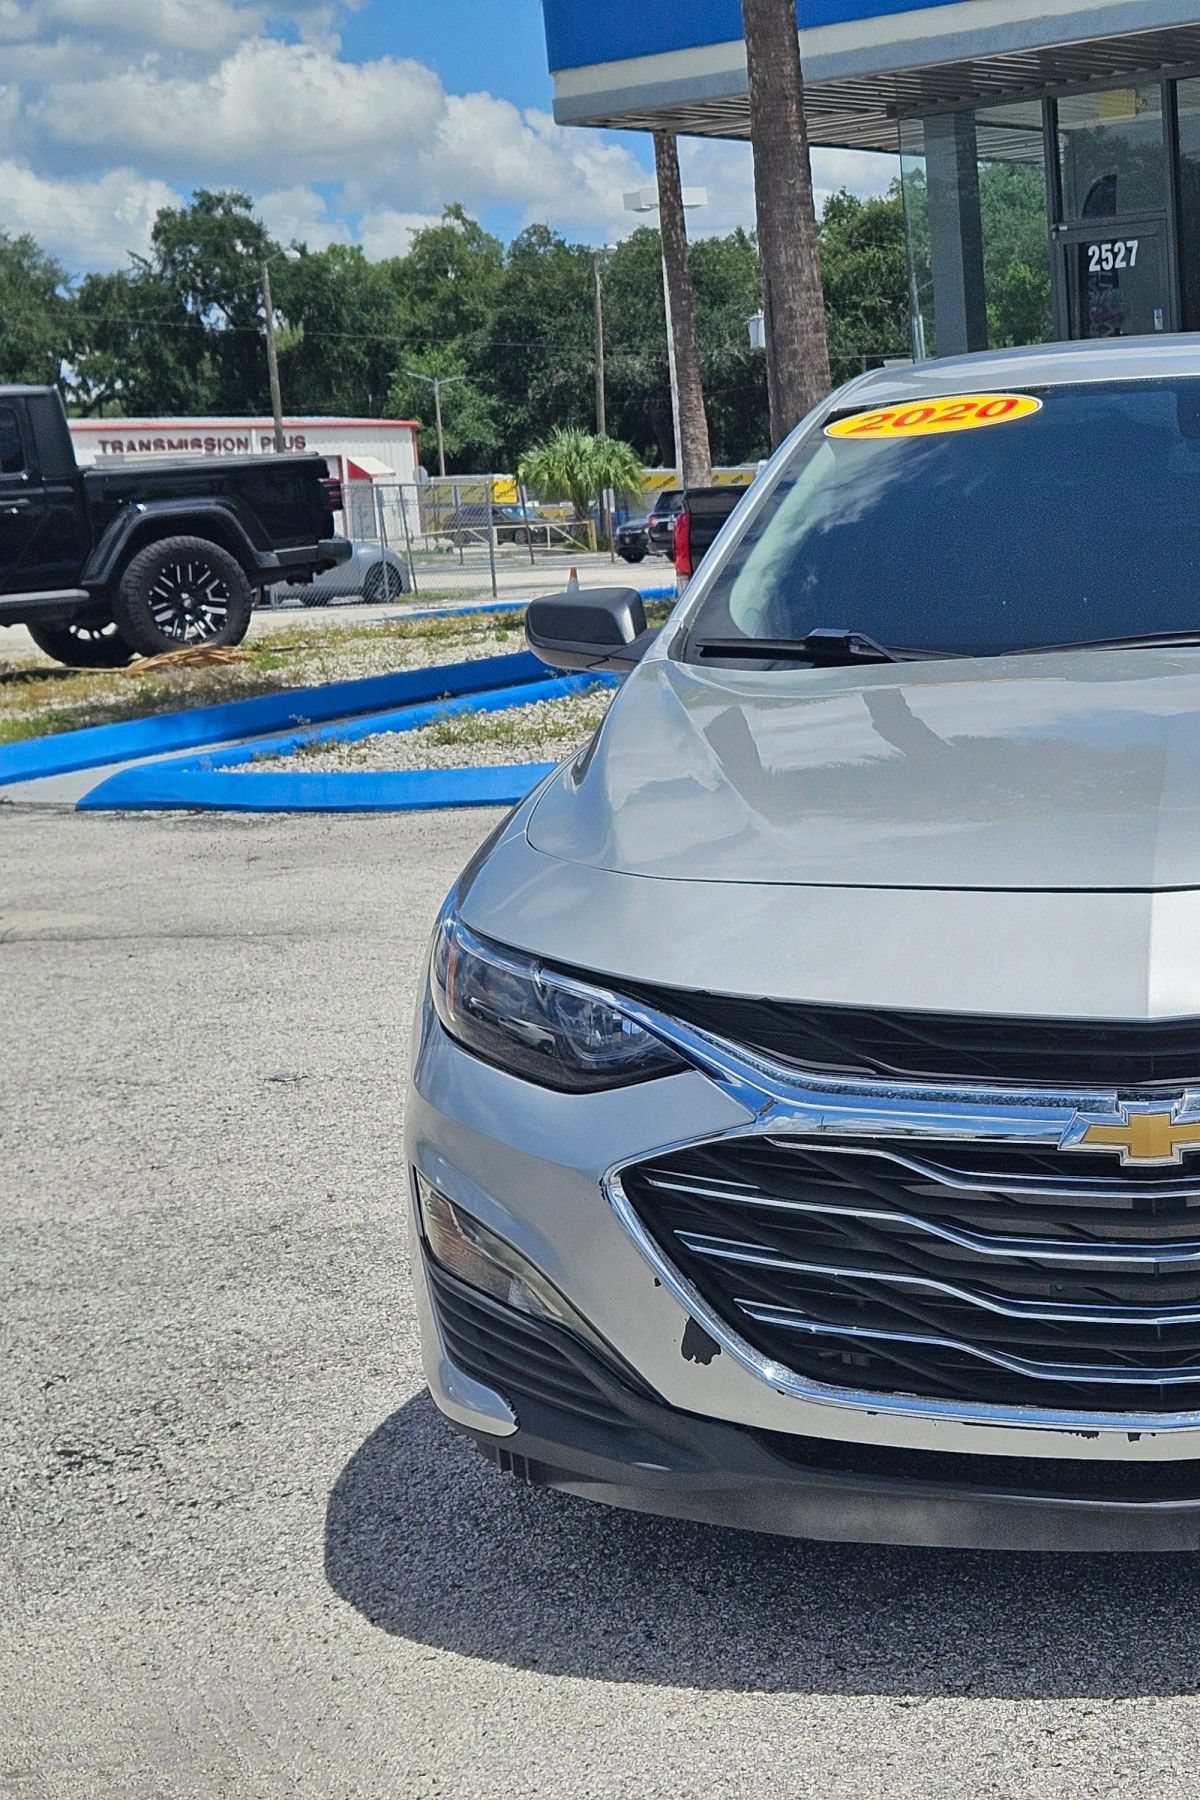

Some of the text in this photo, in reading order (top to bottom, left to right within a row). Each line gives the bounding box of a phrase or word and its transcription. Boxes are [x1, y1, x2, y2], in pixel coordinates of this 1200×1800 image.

[1088, 240, 1138, 272] 2527
[846, 399, 1019, 434] 2020
[98, 436, 249, 454] TRANSMISSION
